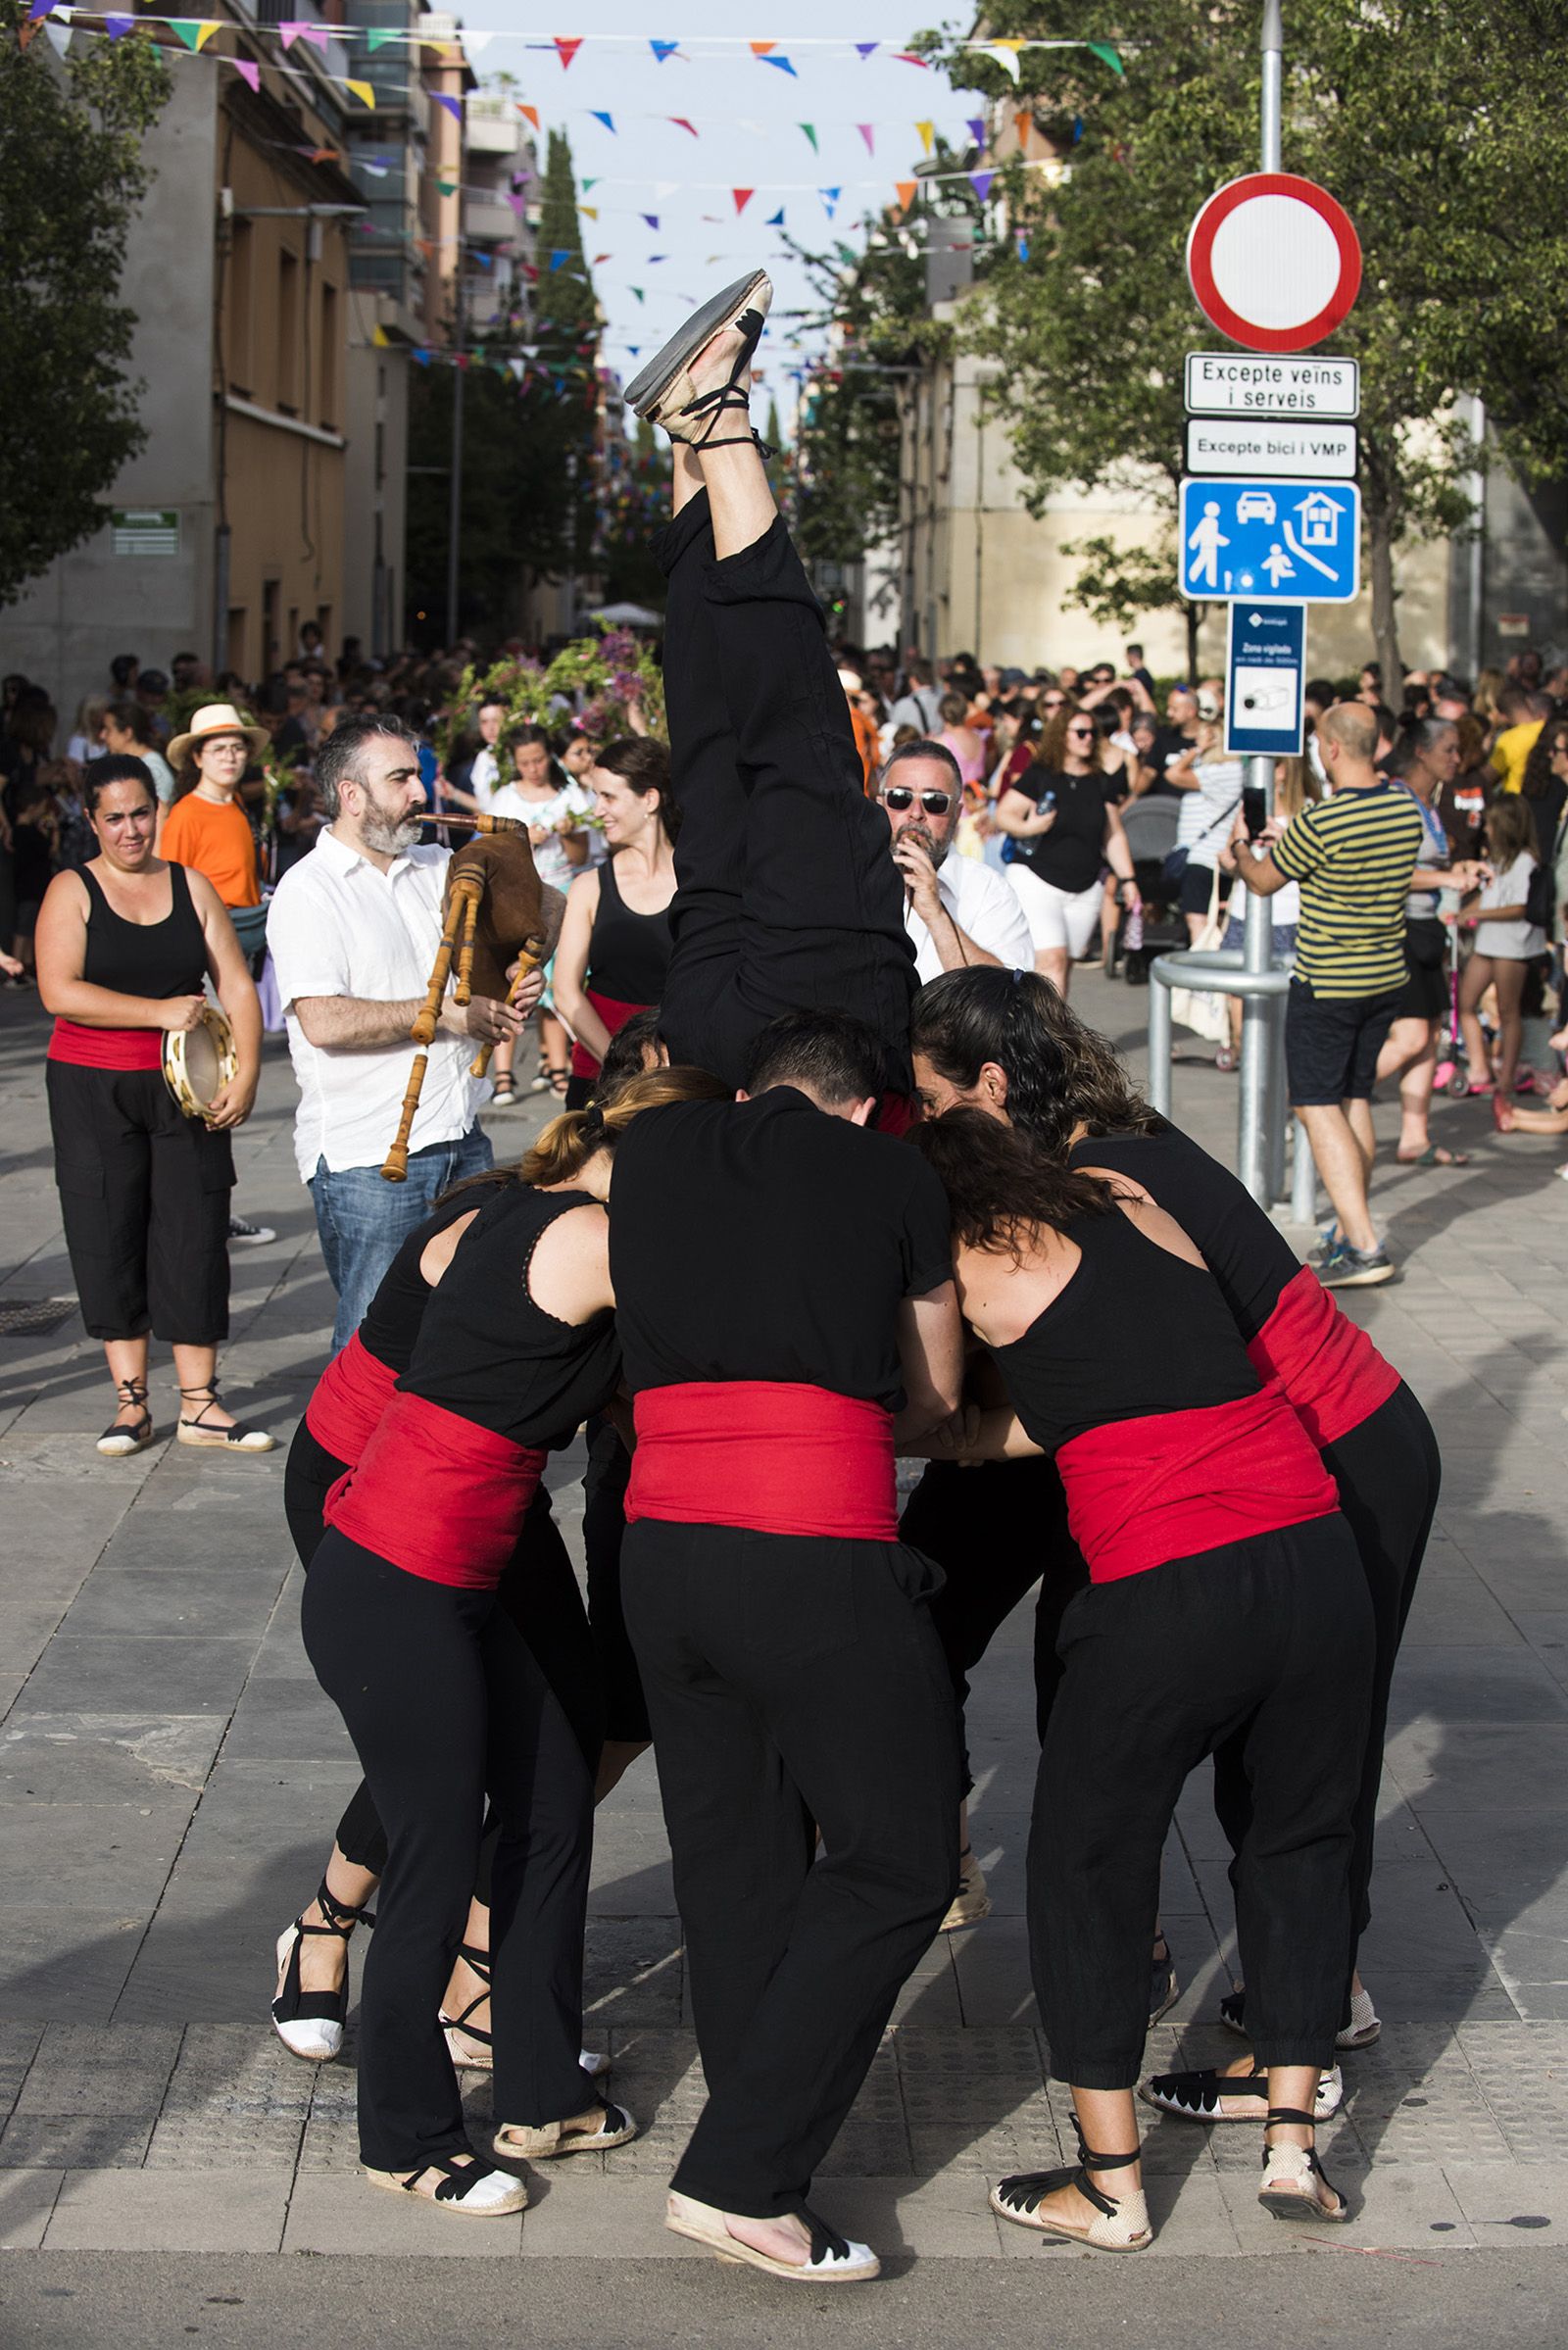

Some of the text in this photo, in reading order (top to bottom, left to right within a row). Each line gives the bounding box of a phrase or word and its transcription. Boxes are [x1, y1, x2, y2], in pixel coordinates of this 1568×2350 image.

[1202, 362, 1343, 385] Excepte veïns
[1229, 386, 1316, 408] i serveis
[1198, 438, 1262, 457] Excepte
[1267, 441, 1296, 456] bici
[1309, 443, 1348, 457] VMP
